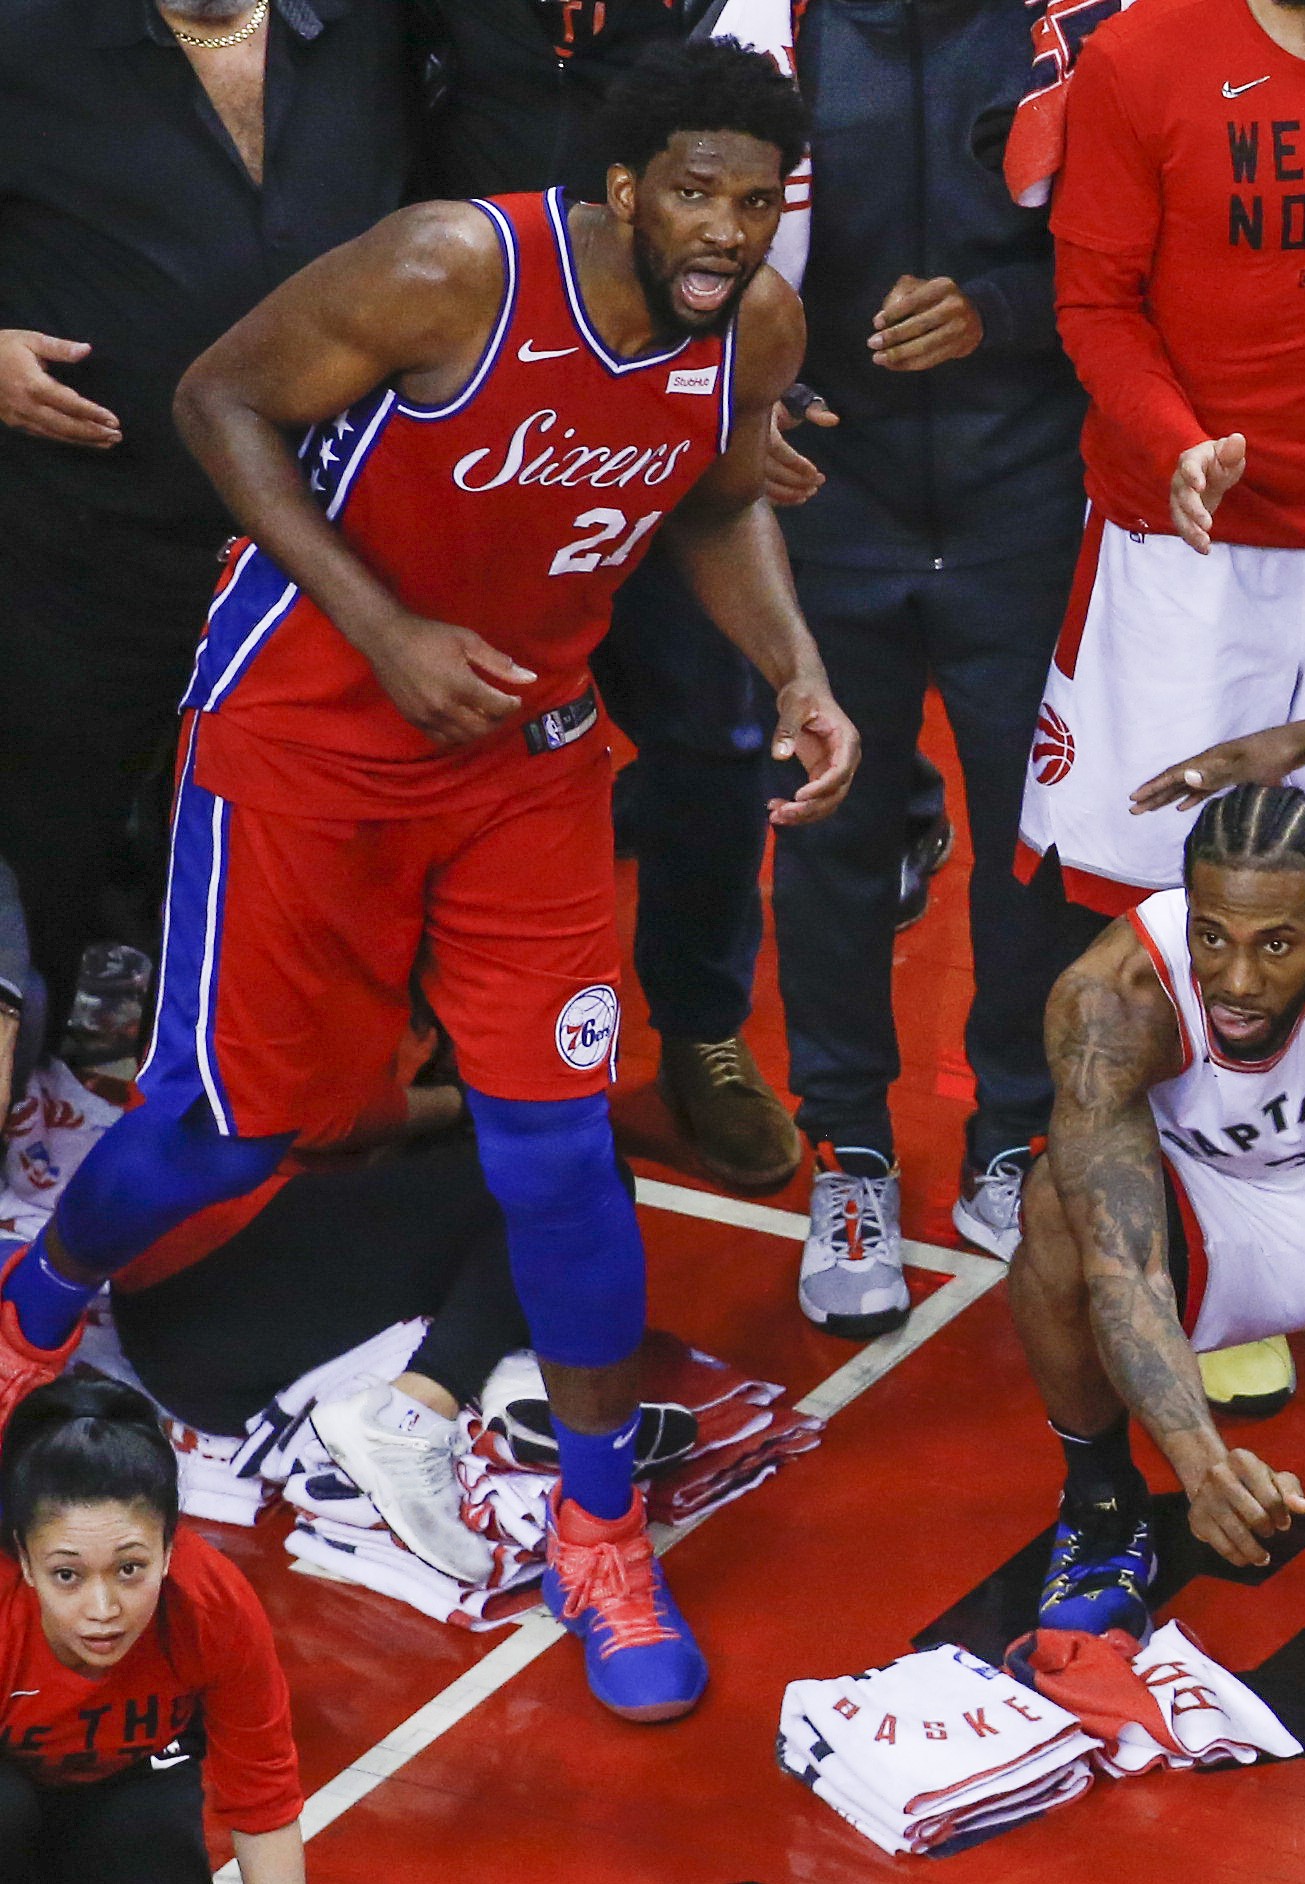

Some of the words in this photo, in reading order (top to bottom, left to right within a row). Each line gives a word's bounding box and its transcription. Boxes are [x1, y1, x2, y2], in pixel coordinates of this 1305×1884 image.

[1227, 120, 1304, 183] WE
[453, 408, 691, 492] Sixers
[548, 507, 662, 576] 21
